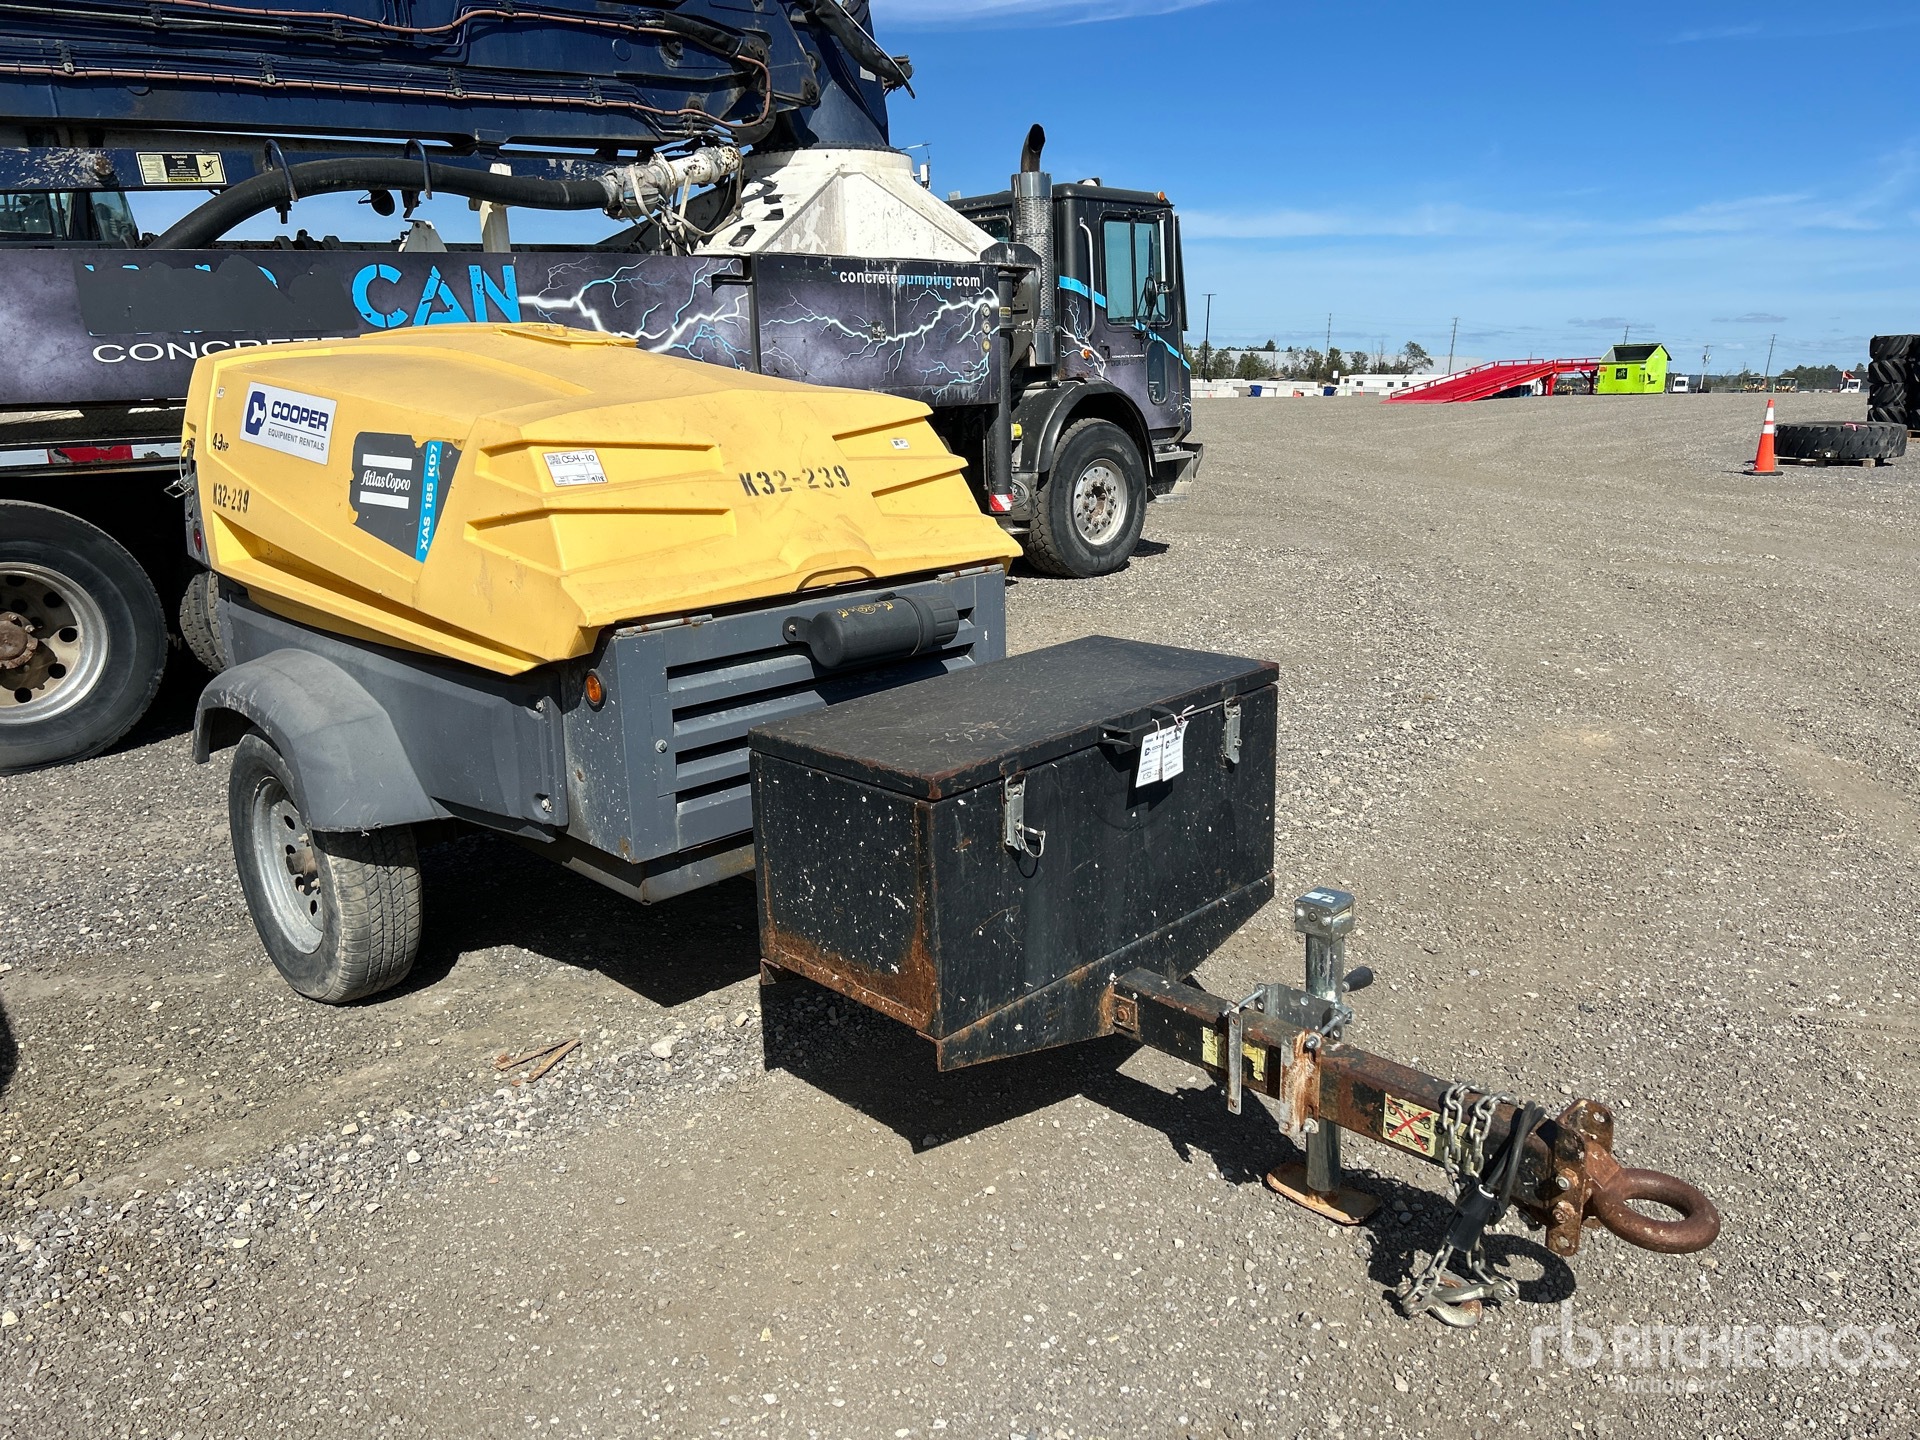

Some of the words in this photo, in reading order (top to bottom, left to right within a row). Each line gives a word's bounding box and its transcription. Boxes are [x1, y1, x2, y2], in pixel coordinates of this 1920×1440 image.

[352, 263, 522, 328] CAN
[271, 400, 329, 432] COOPER
[267, 427, 299, 444] EQUIPMENT
[299, 436, 325, 451] RENTALS
[427, 444, 438, 477] KD7
[425, 482, 434, 509] 185
[738, 465, 851, 497] K32-239
[212, 482, 250, 513] K32-239
[420, 516, 431, 551] XAS
